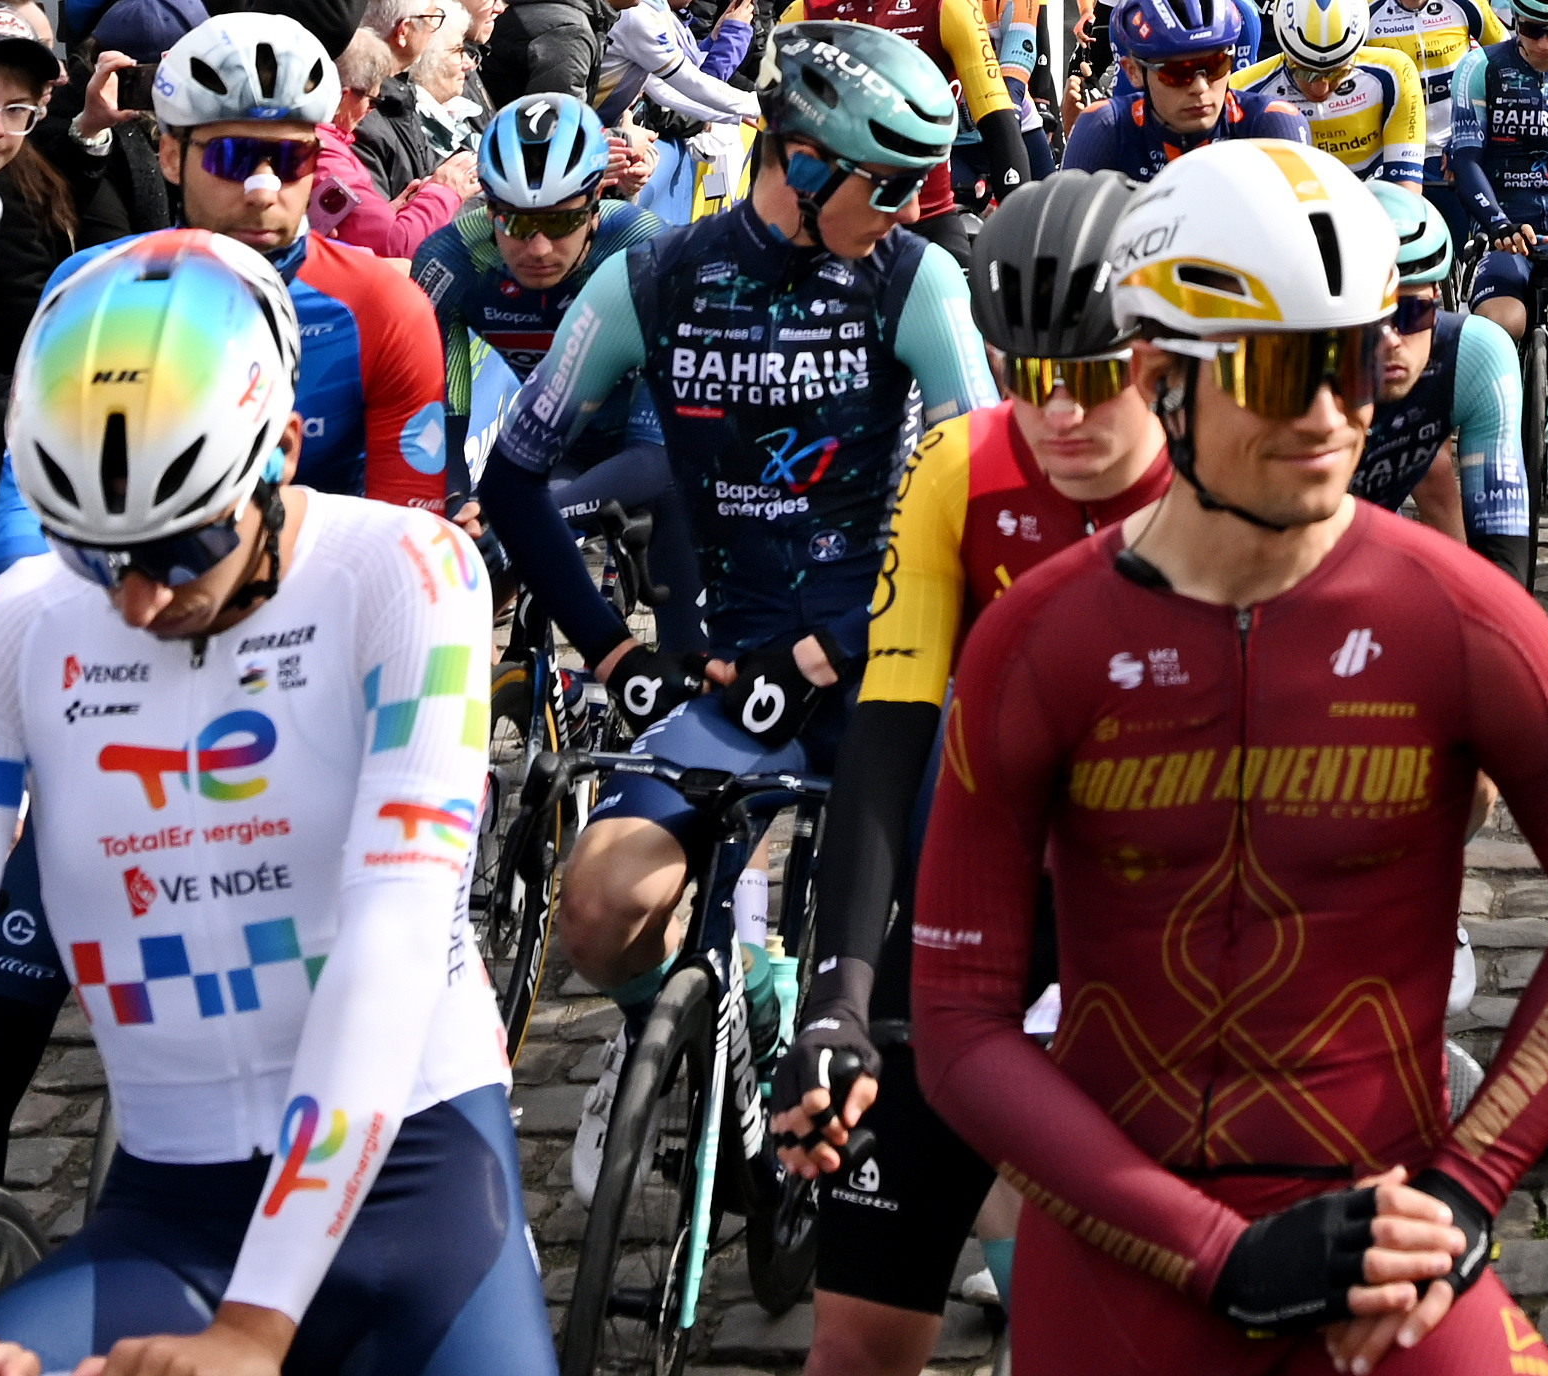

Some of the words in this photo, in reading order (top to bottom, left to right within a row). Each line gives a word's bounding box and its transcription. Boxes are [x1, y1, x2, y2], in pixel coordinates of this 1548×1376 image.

[1422, 14, 1452, 29] CALLANT
[1414, 39, 1441, 51] Team
[1328, 92, 1368, 110] CALLANT
[1314, 127, 1347, 140] Team
[1317, 128, 1379, 154] Flanders
[1503, 171, 1543, 182] Bapco
[483, 305, 542, 325] Ekopak
[534, 303, 595, 423] Bianchi
[671, 346, 868, 386] BAHRAIN
[91, 369, 150, 386] HJC
[671, 371, 870, 406] VICTORIOUS
[715, 480, 781, 500] Bapco
[717, 496, 810, 521] energies
[81, 662, 151, 685] VENDÉE
[1069, 748, 1216, 812] MODERN
[1211, 744, 1435, 804] ADVENTURE
[158, 862, 293, 905] VENDÉE
